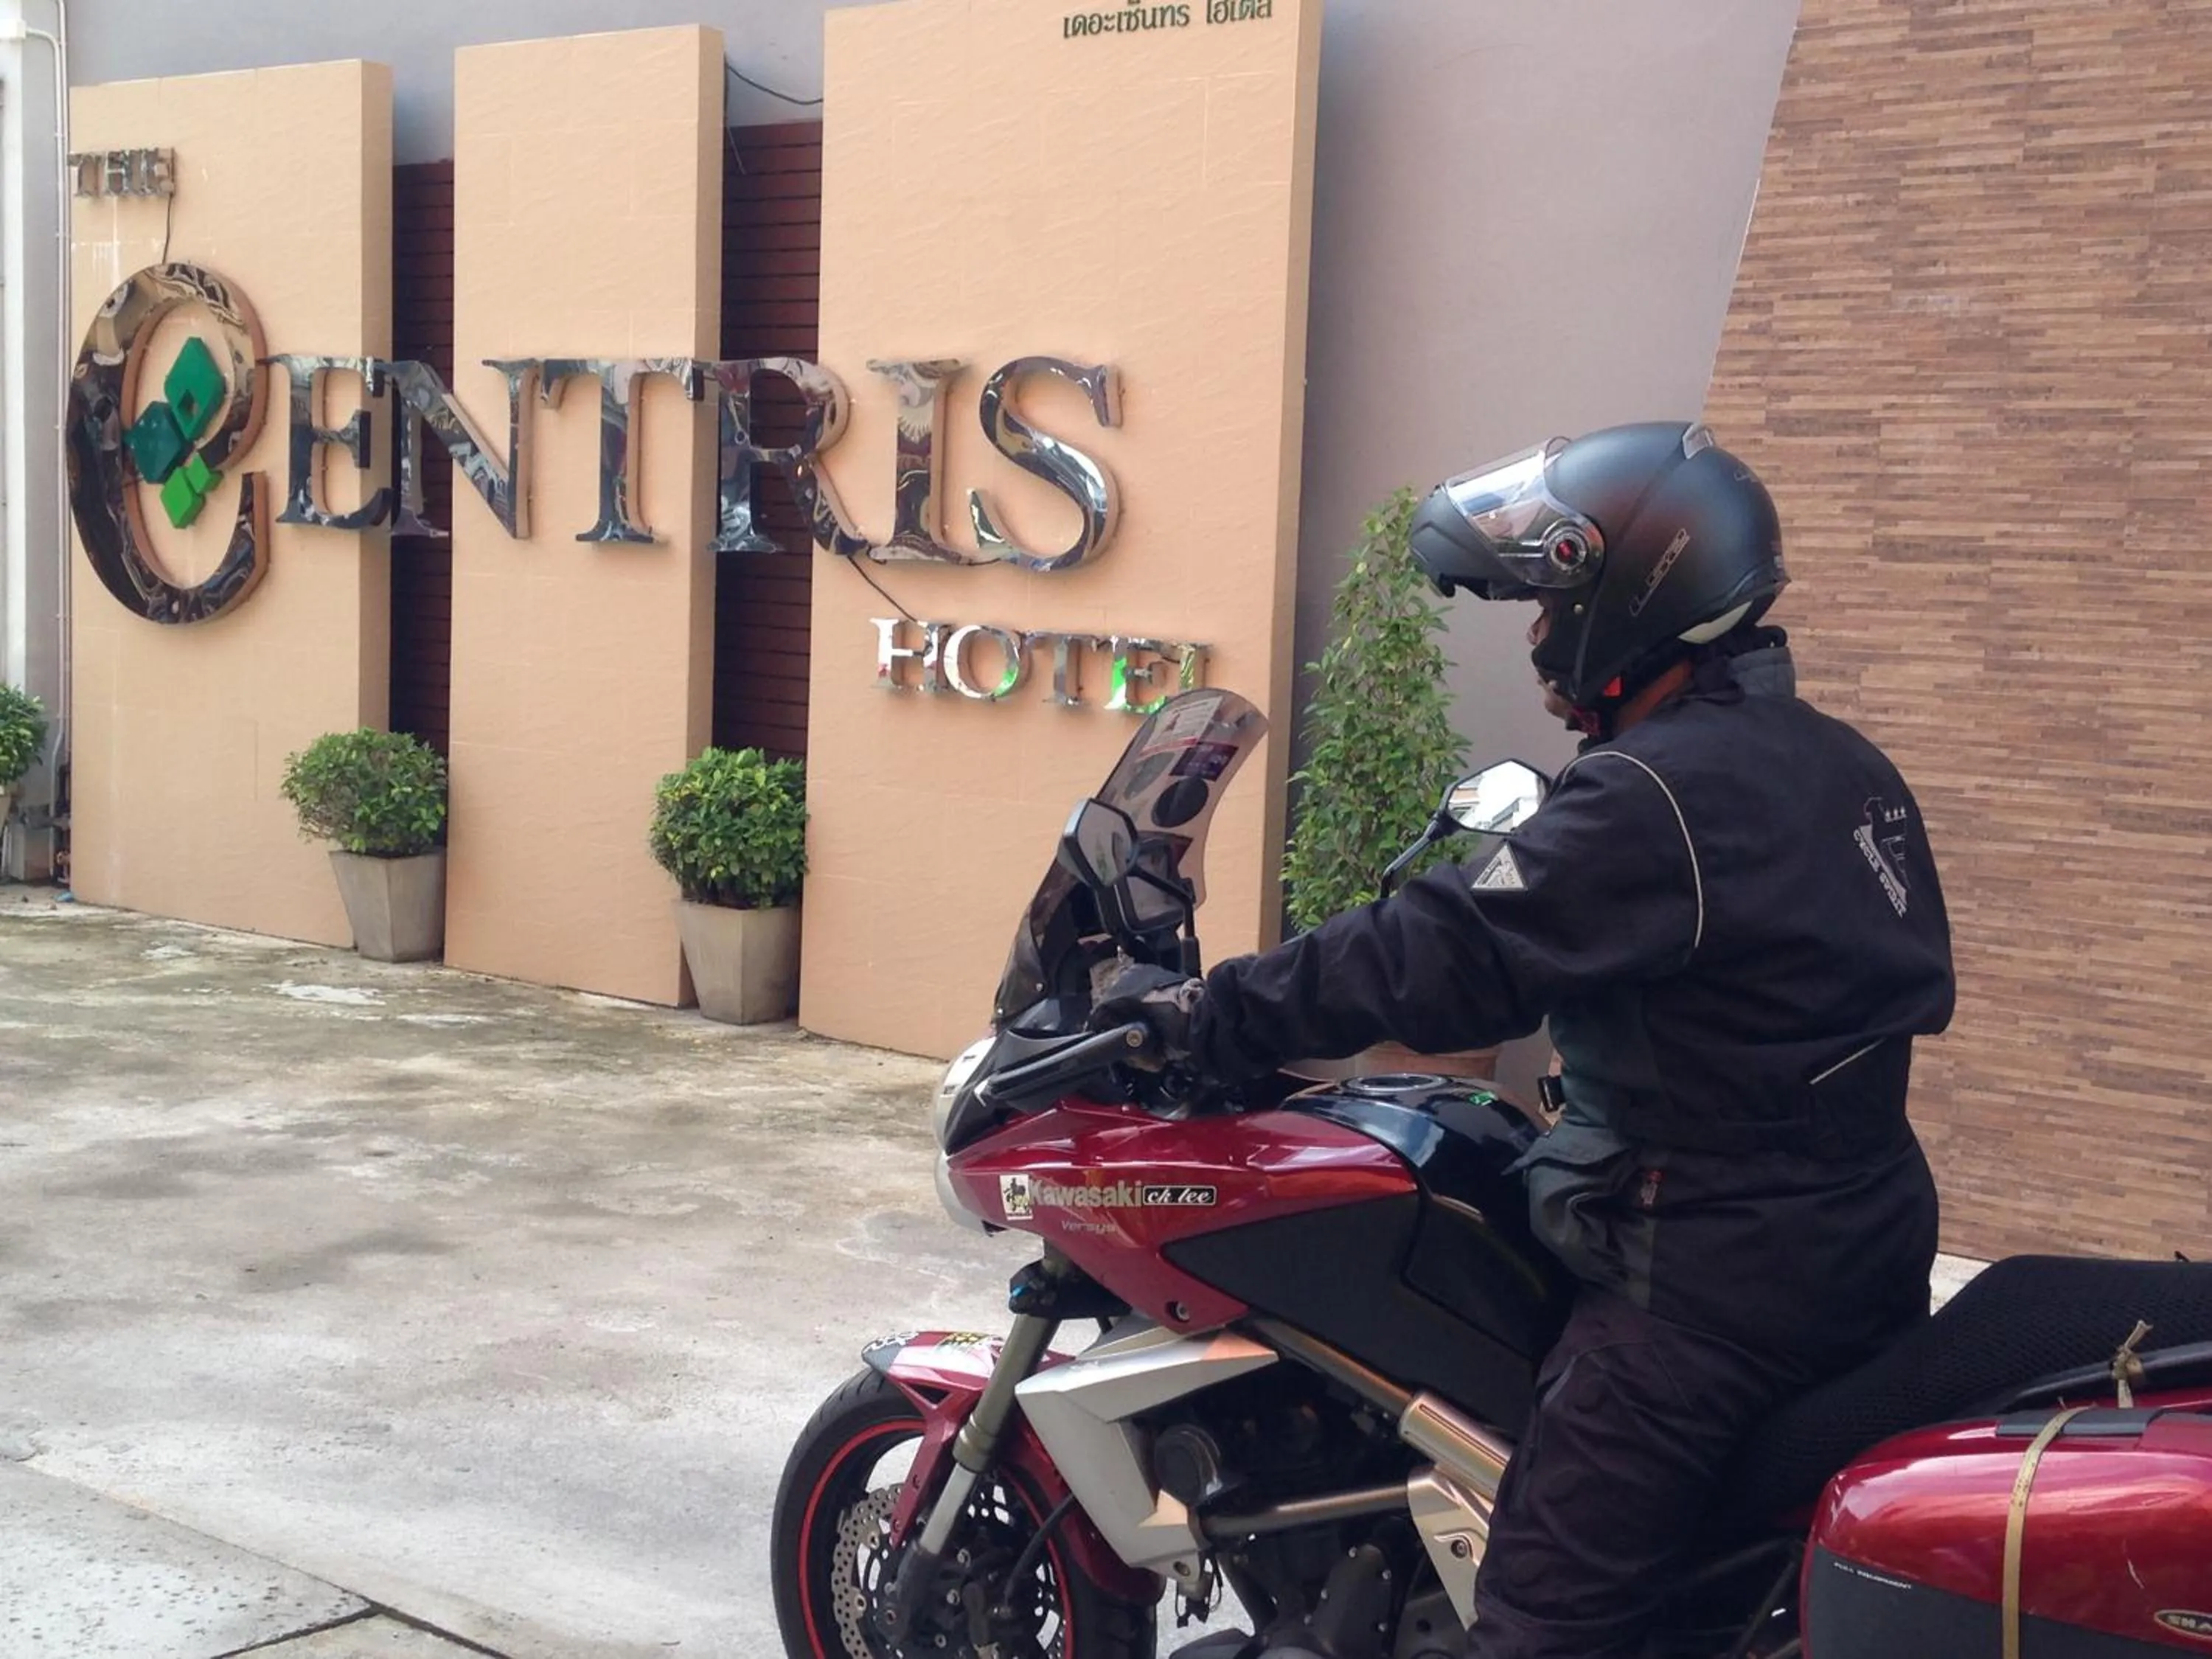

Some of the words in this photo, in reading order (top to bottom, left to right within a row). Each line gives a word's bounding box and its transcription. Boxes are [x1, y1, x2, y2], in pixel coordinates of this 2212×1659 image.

[67, 147, 175, 197] THE
[66, 262, 1124, 624] CENTRIS
[1029, 1179, 1142, 1207] Kawasaki
